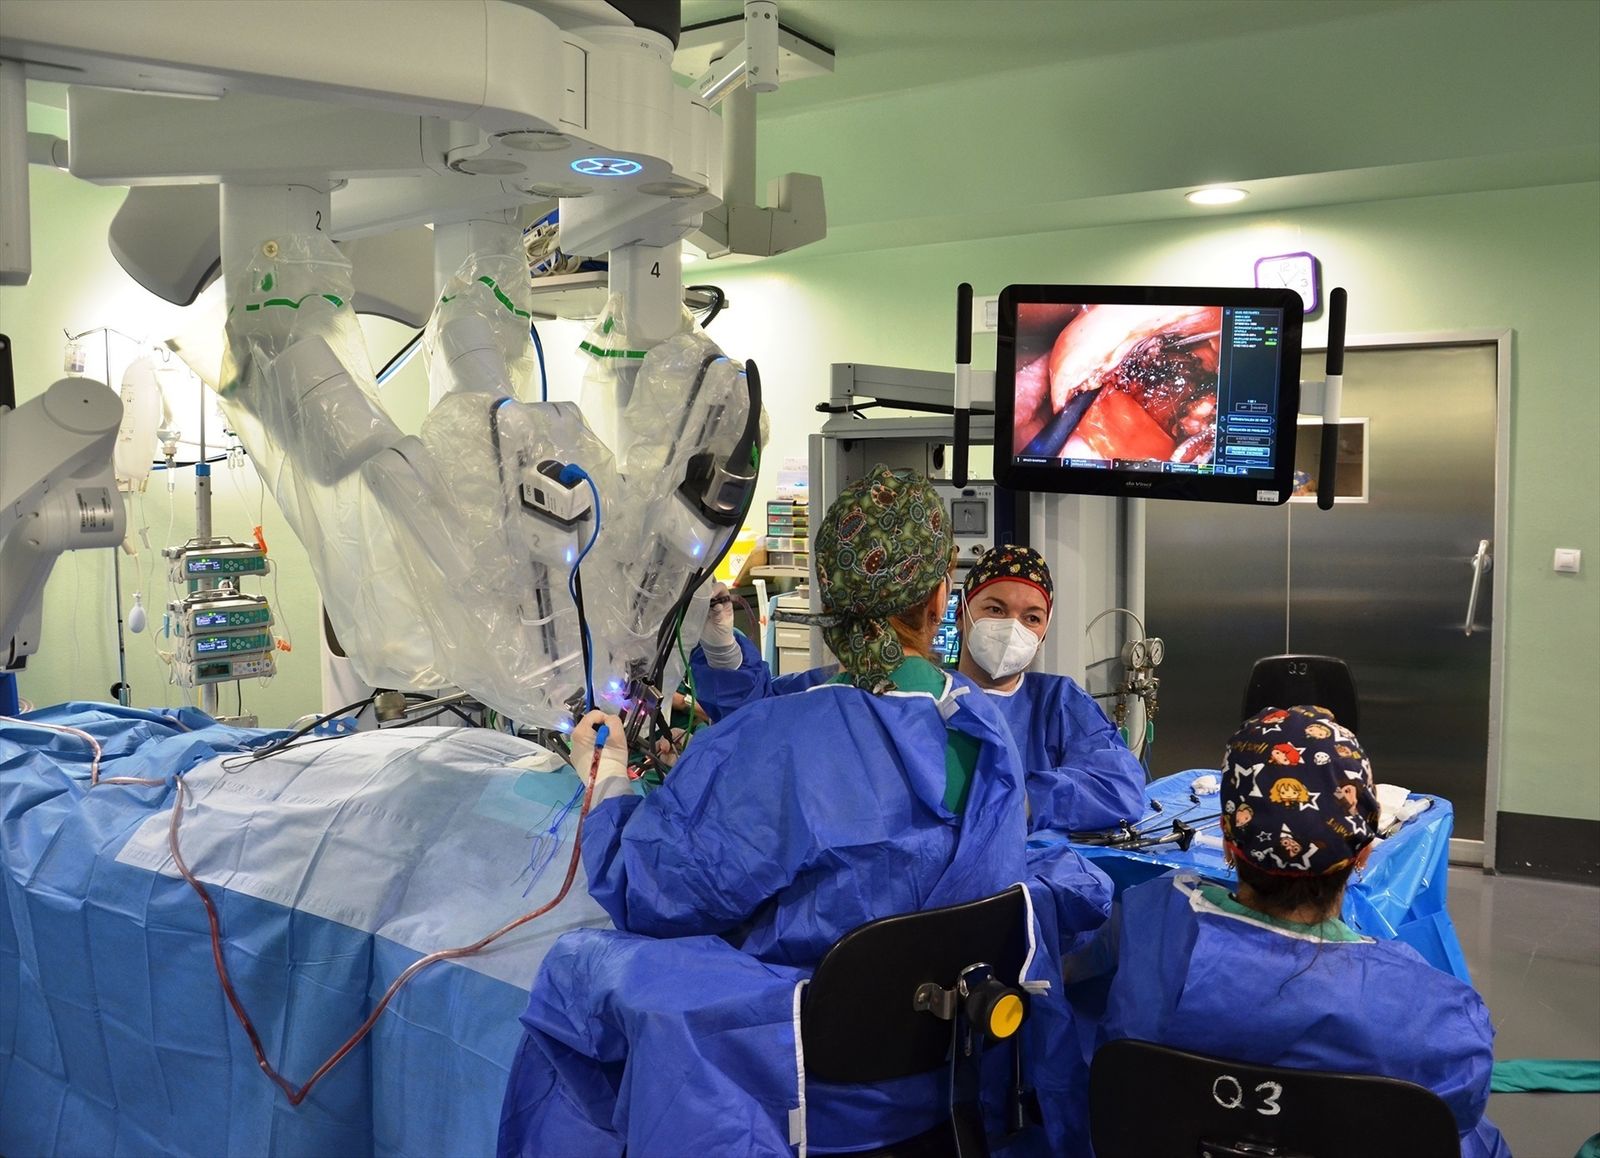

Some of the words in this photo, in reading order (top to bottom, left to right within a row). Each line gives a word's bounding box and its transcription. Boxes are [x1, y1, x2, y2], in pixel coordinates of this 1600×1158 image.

[315, 210, 322, 231] 2
[650, 261, 661, 279] 4
[1300, 278, 1309, 288] 3
[532, 534, 540, 548] 2
